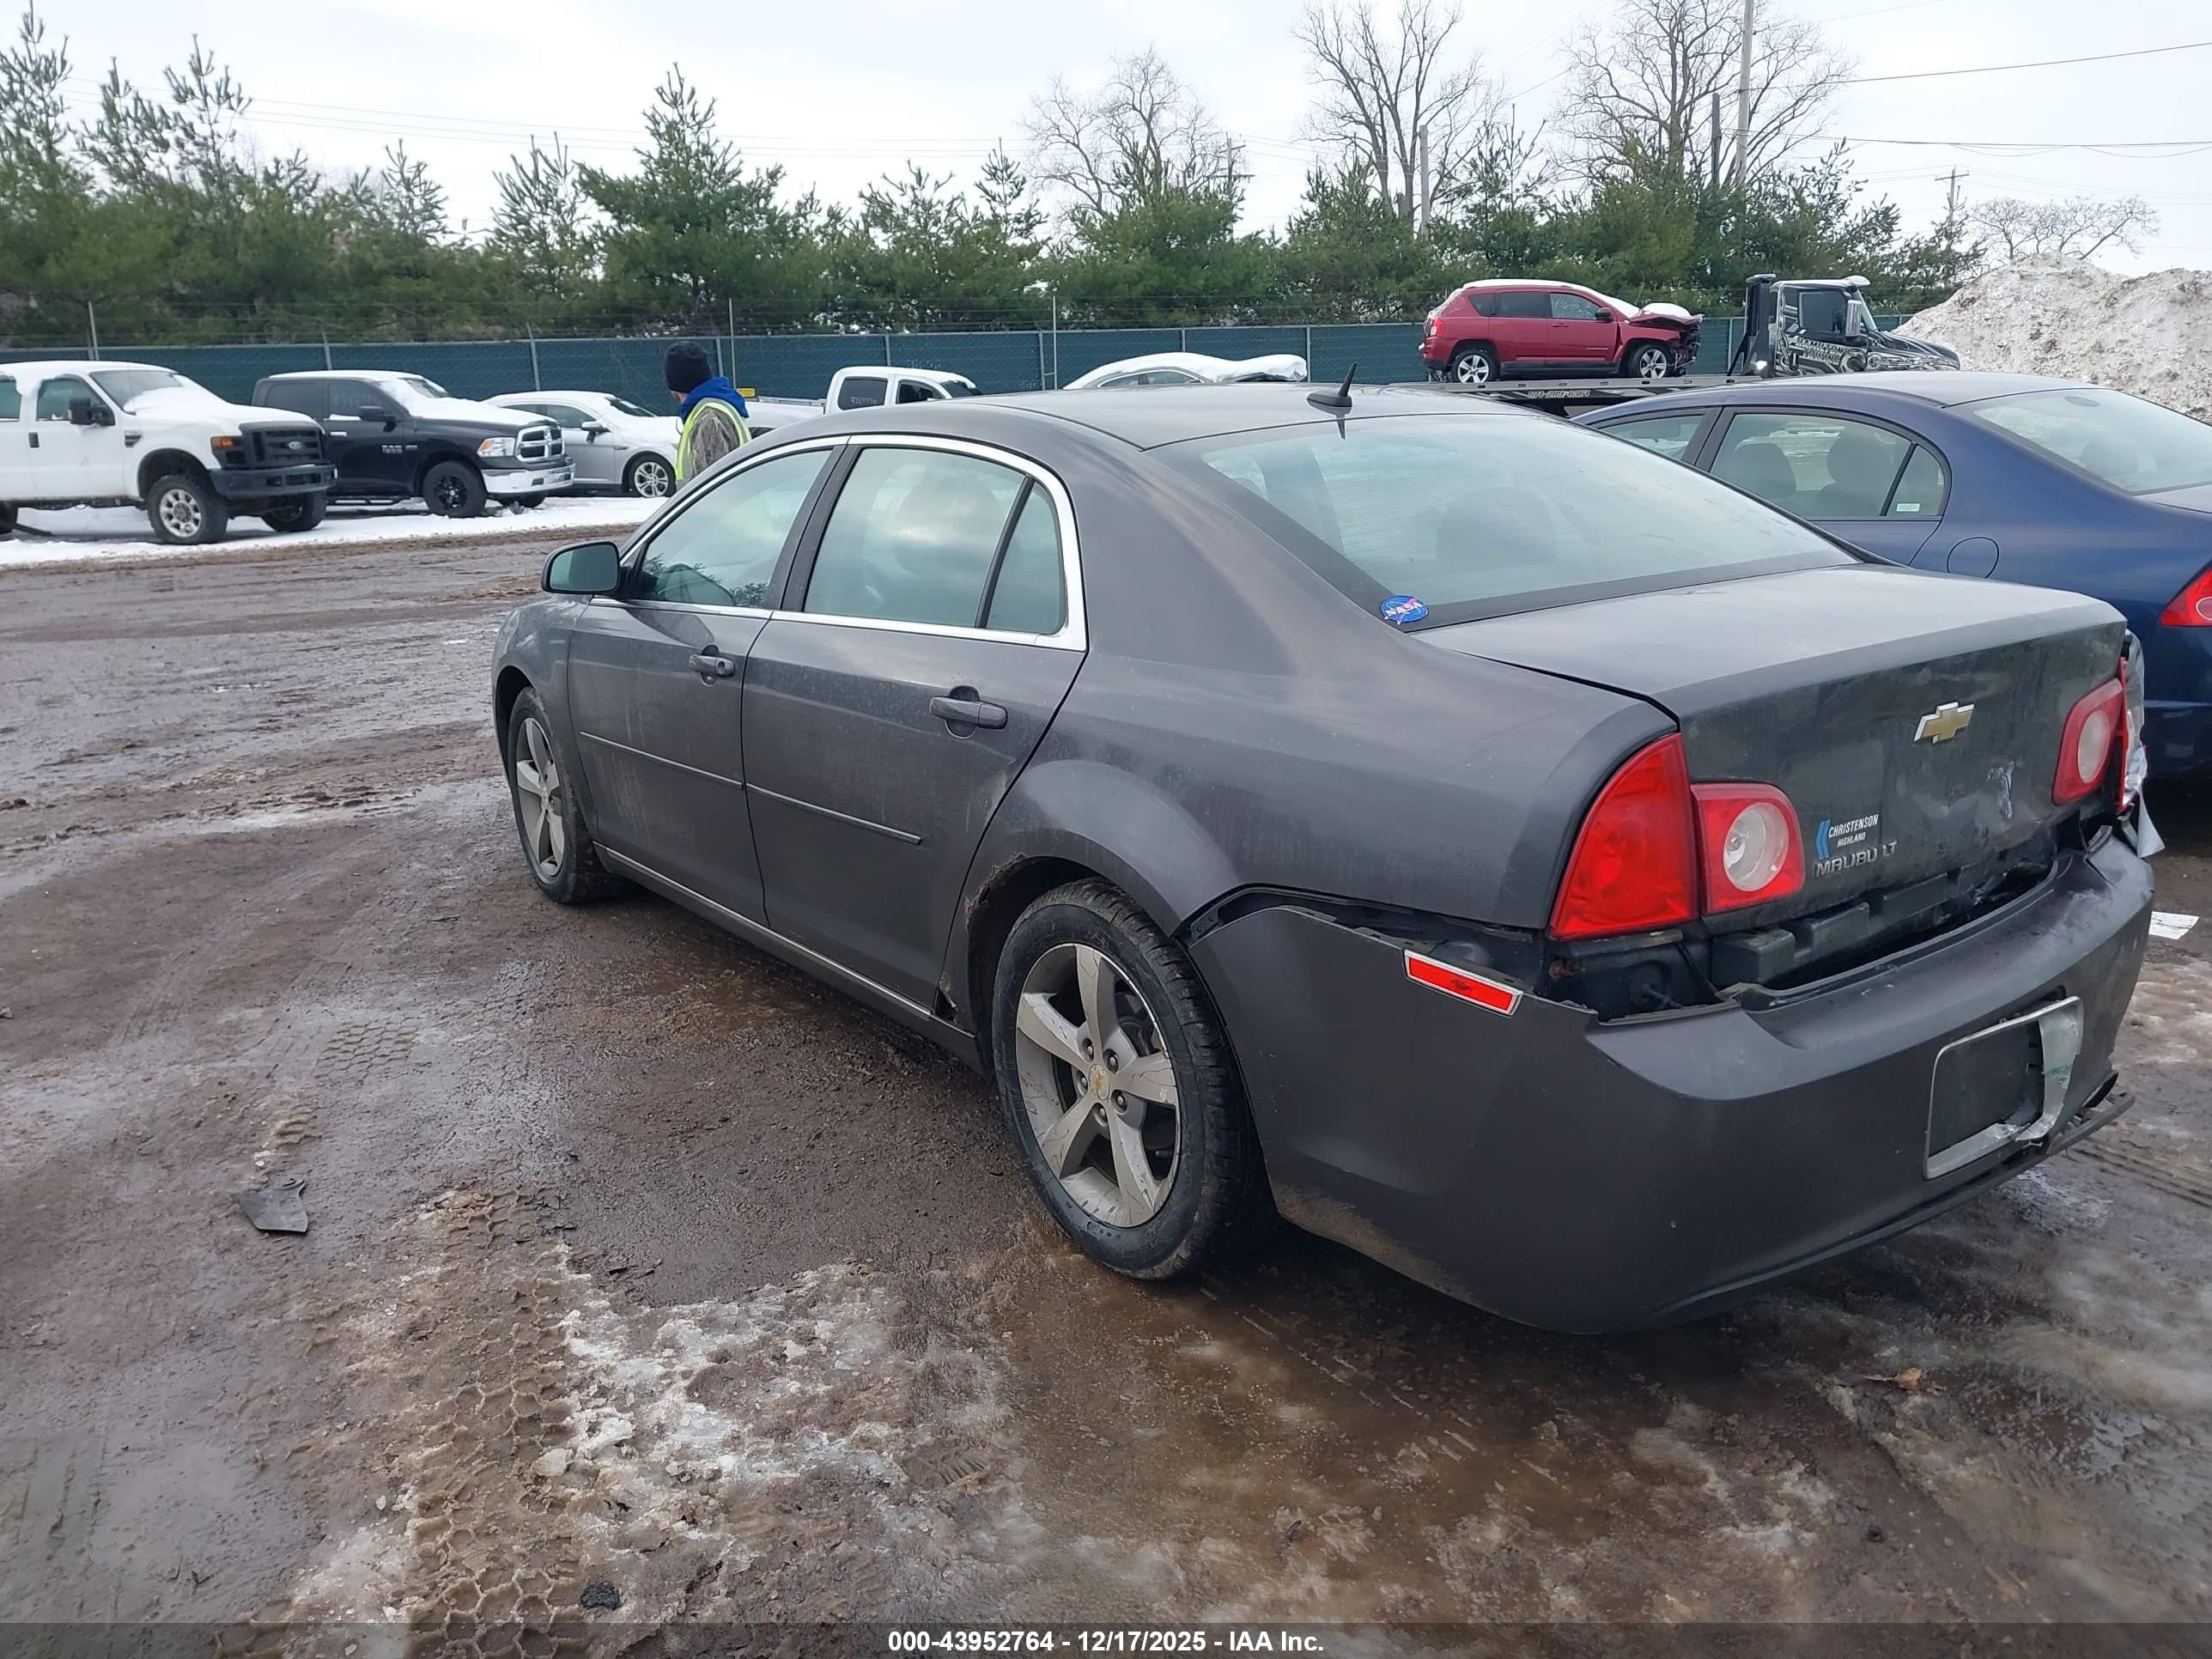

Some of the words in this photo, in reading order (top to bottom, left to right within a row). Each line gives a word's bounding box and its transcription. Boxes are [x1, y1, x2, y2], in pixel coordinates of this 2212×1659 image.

[1797, 337, 1844, 356] HAMILTON
[1803, 349, 1841, 364] TOWING
[1385, 602, 1423, 617] NASA
[1828, 813, 1879, 838] CHRISTENSON
[1838, 832, 1866, 848] HIGHLAND
[1815, 848, 1878, 877] MALIBU
[1882, 841, 1897, 857] LT
